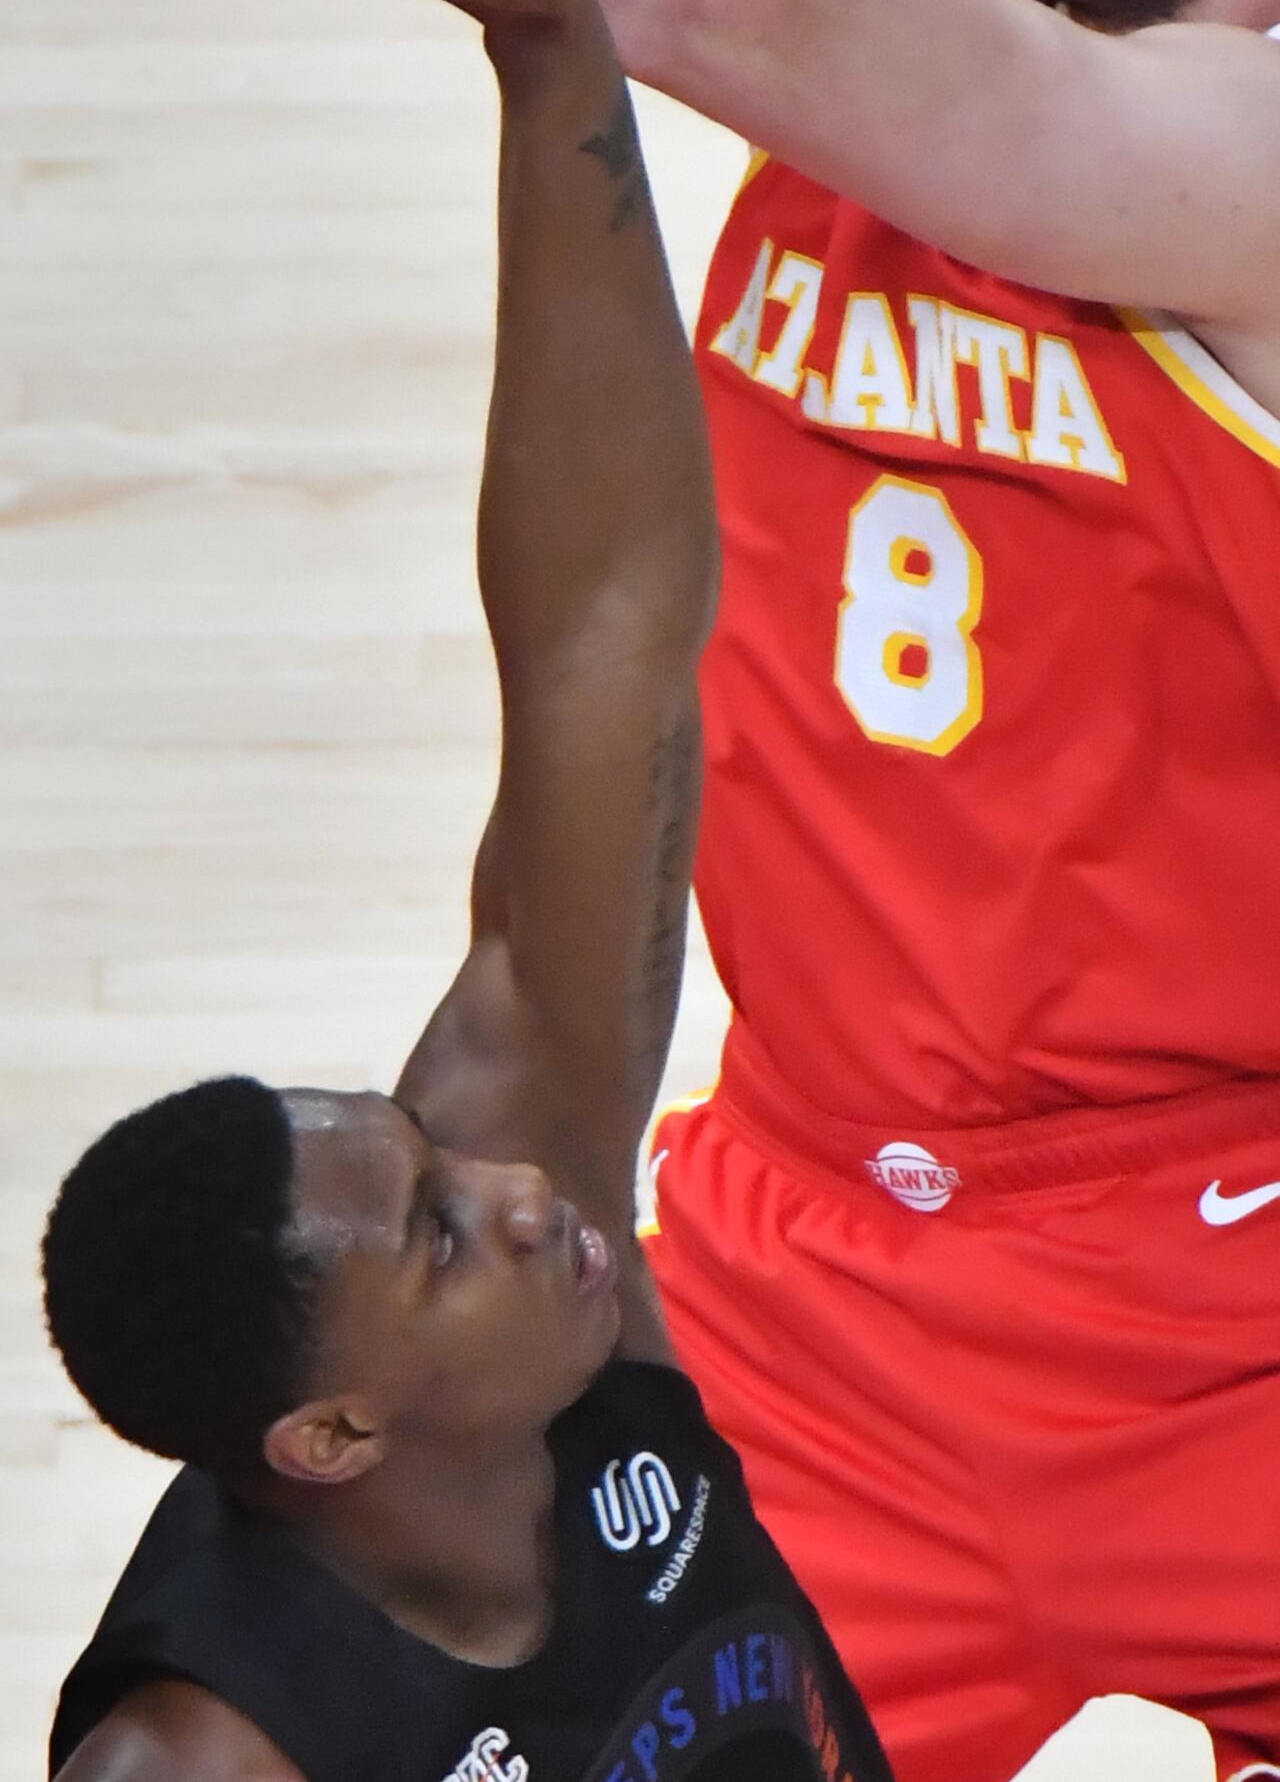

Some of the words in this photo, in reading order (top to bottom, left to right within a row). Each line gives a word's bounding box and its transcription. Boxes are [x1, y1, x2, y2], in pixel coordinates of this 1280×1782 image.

[707, 236, 1128, 486] ATANTA
[834, 473, 984, 758] 8
[648, 1473, 712, 1604] SQUARESPACE
[713, 1631, 795, 1717] NEW
